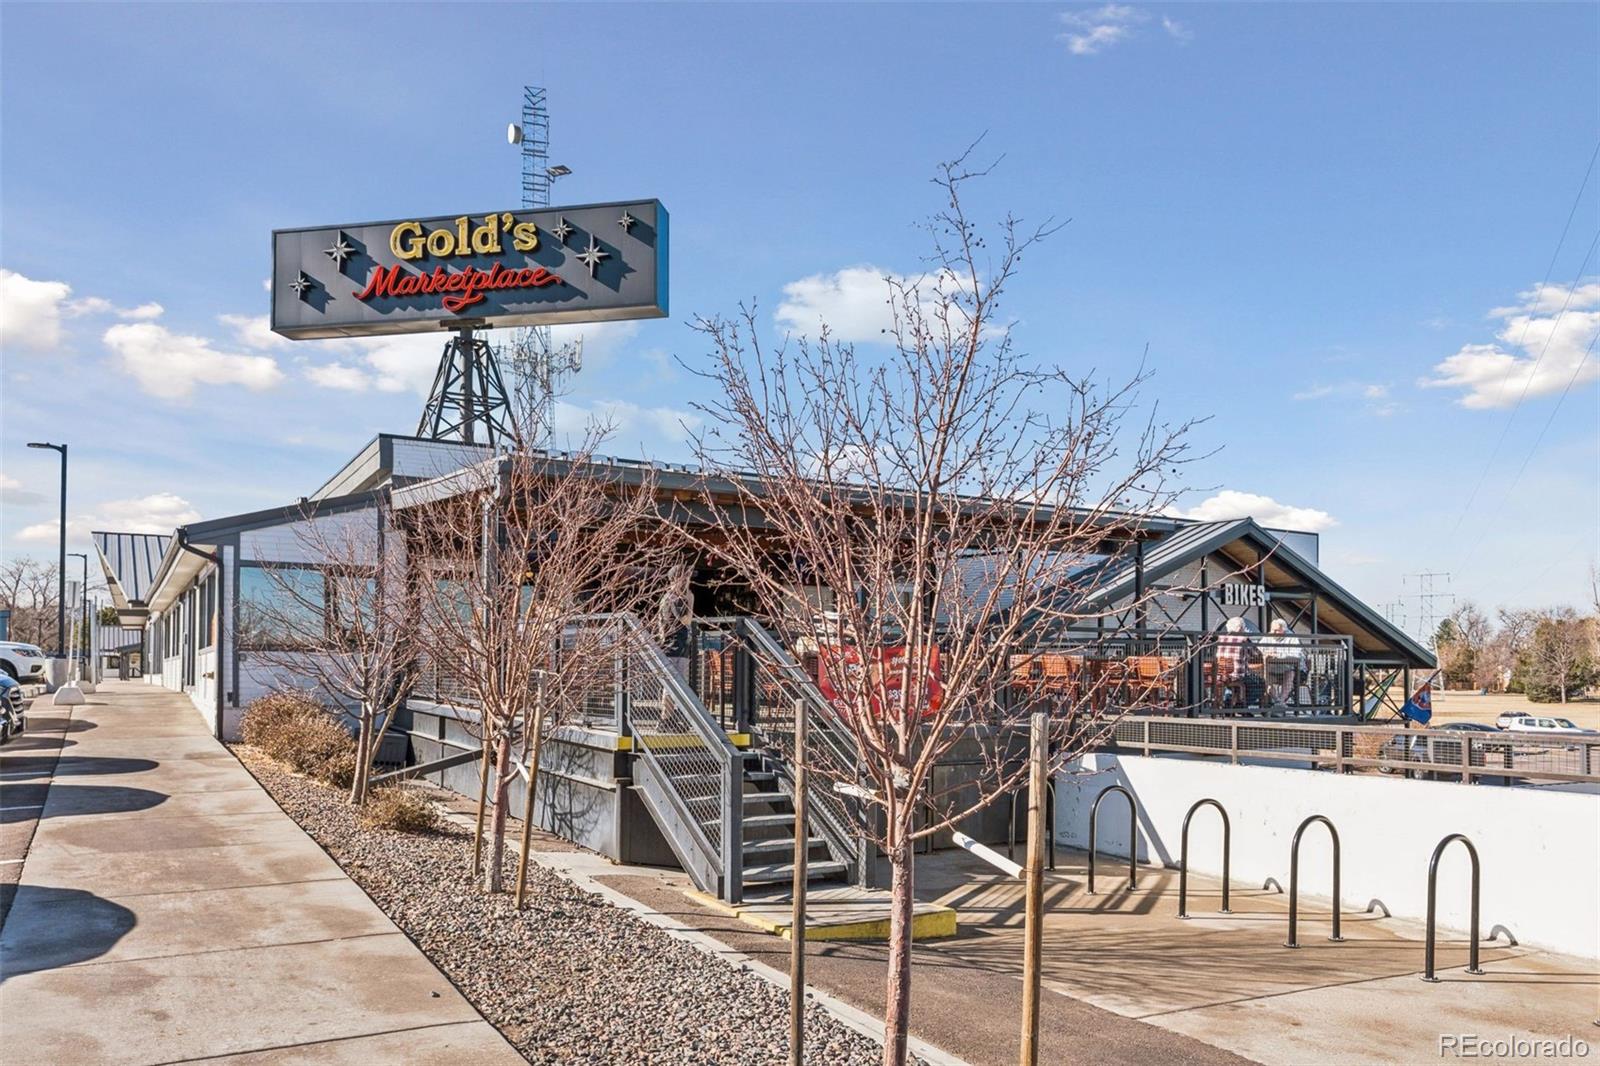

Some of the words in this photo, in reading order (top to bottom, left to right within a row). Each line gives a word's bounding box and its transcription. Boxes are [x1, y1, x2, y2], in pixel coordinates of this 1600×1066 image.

[389, 213, 538, 260] Gold's
[352, 261, 561, 312] Marketplace
[1225, 583, 1265, 606] BIKES
